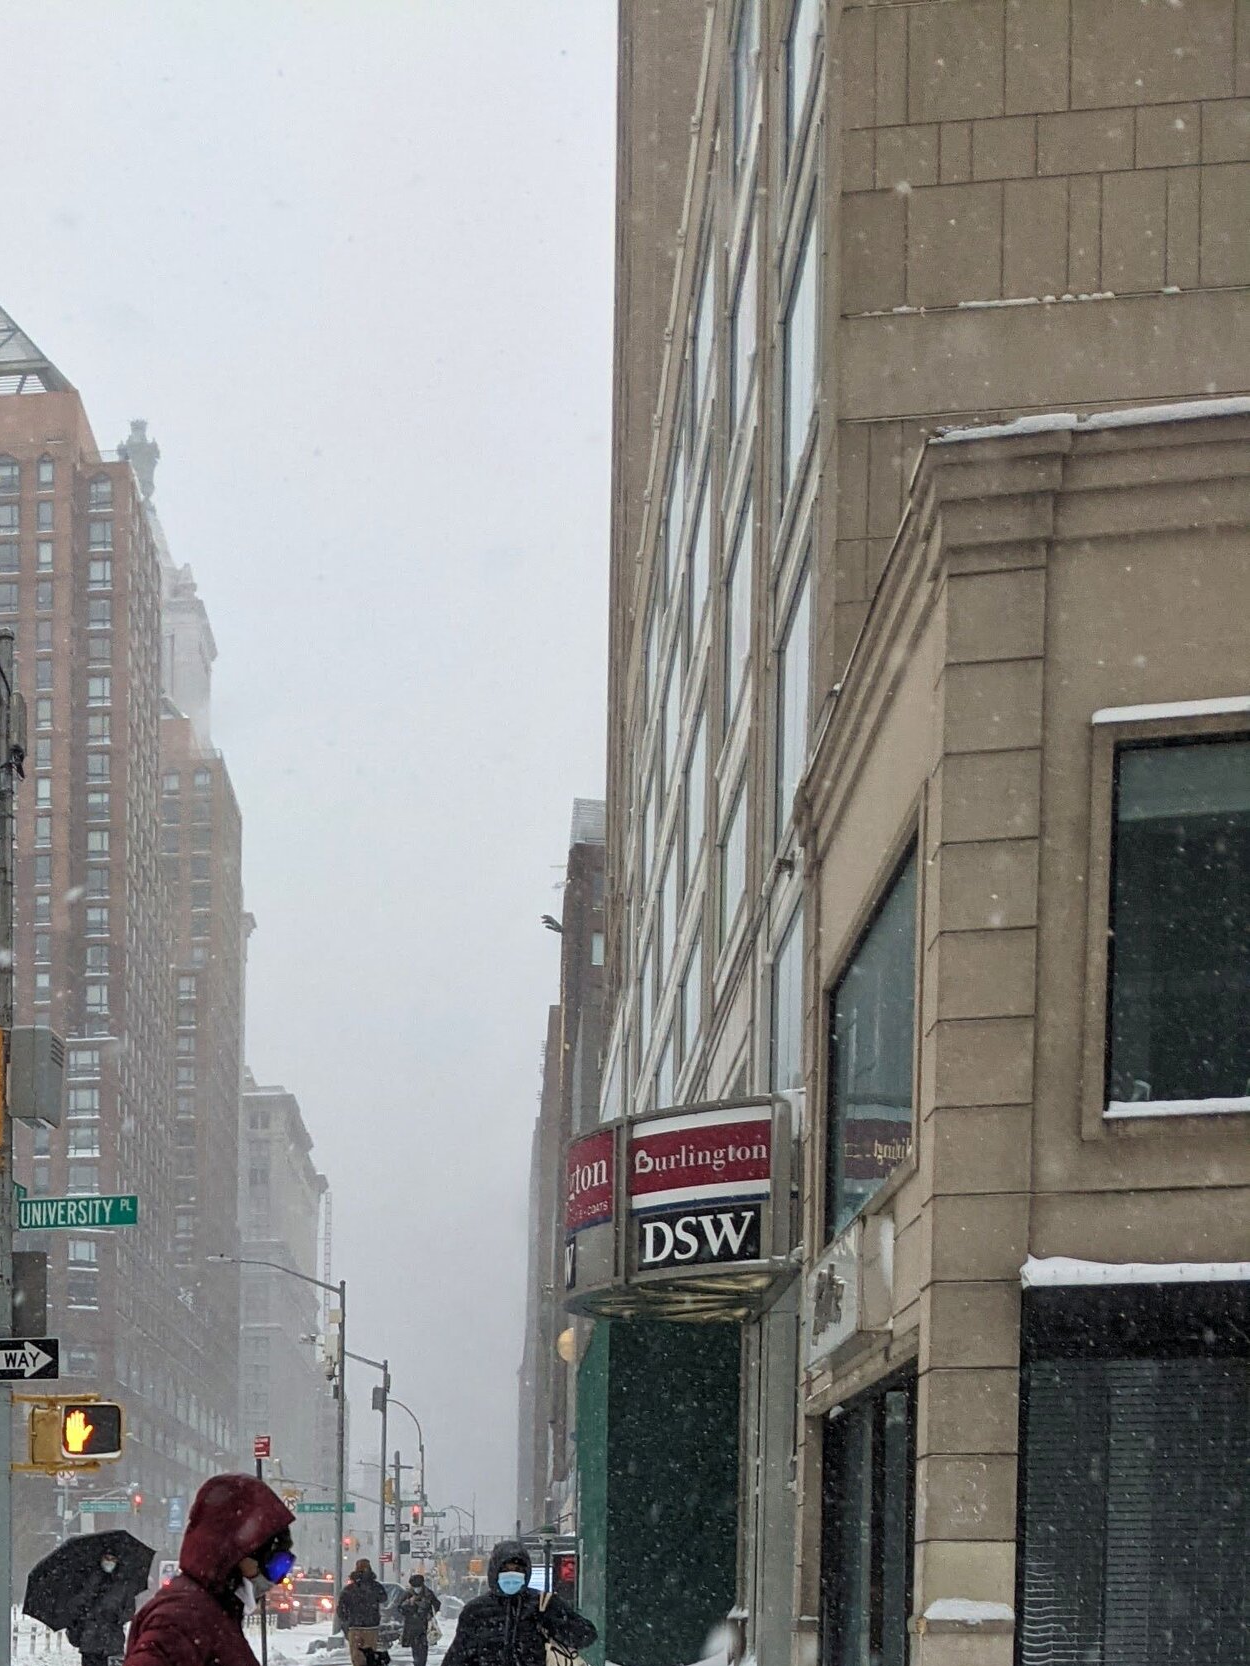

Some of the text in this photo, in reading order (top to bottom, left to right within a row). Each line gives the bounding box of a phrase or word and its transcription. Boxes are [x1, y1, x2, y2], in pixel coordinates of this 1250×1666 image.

[635, 1144, 767, 1174] Burlington
[20, 1199, 132, 1226] UNIVERSITY PL
[642, 1210, 755, 1263] DSW
[4, 1351, 41, 1368] WAY
